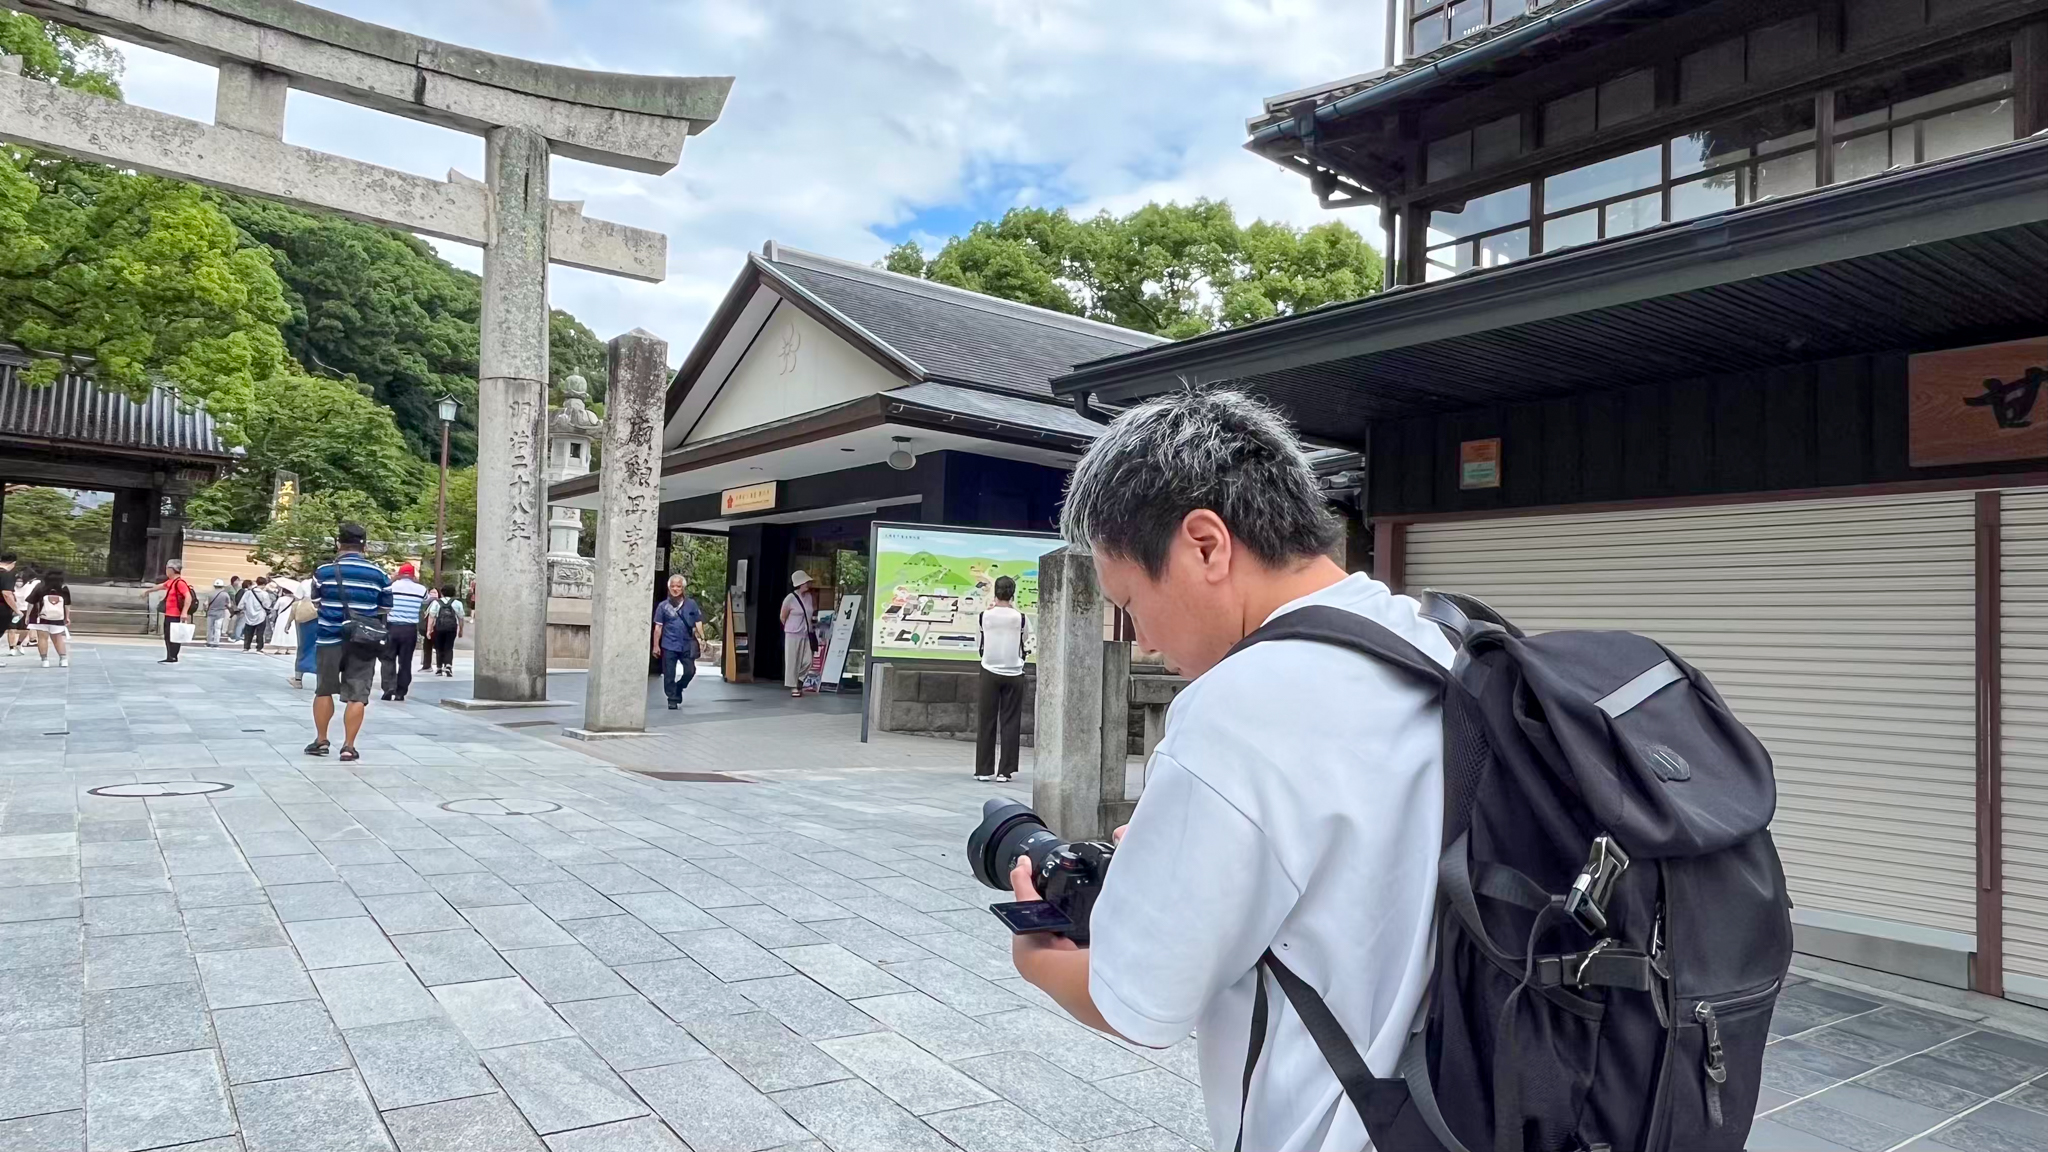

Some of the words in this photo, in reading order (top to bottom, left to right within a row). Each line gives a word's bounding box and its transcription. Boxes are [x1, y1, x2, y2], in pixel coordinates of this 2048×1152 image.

[507, 401, 531, 552] 明治二十八年
